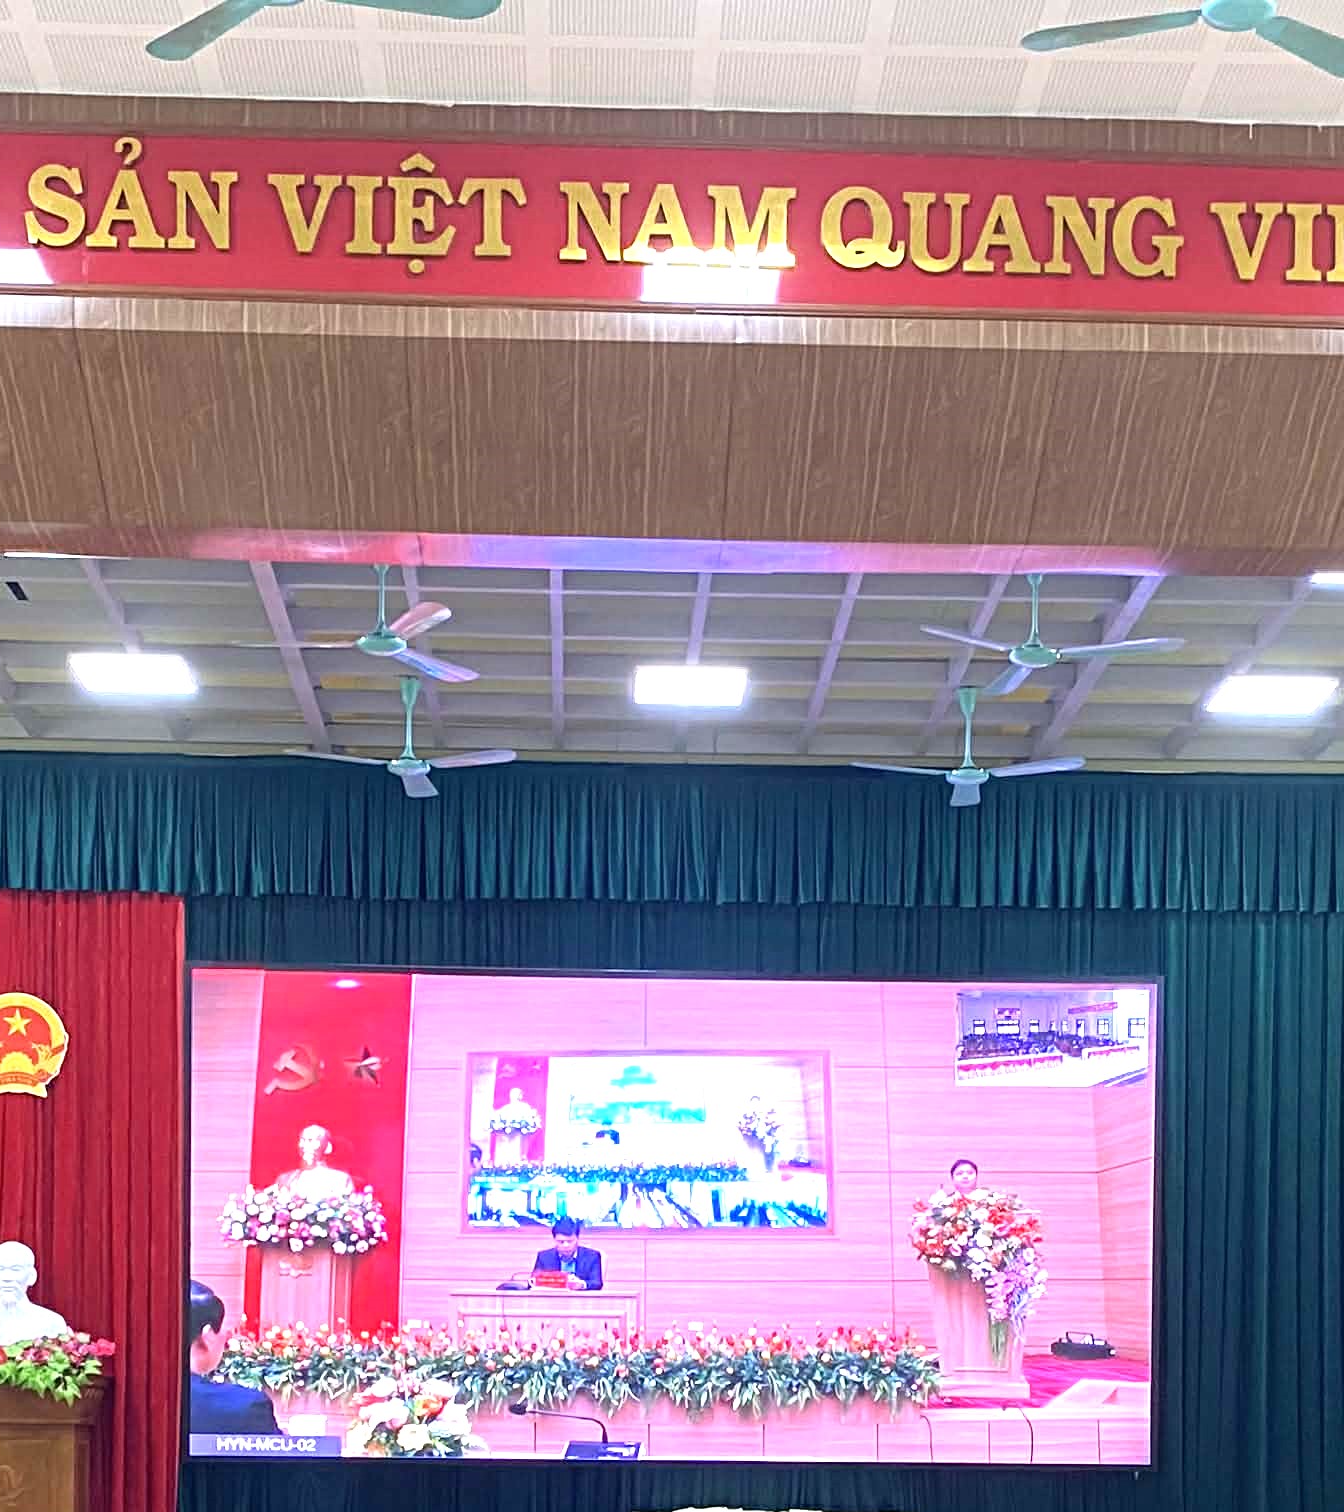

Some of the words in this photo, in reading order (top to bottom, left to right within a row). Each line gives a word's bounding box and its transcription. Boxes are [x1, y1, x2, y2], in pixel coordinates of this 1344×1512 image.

[26, 138, 238, 251] SẢN
[269, 152, 526, 274] VIỆT
[558, 181, 797, 270] NAM
[822, 187, 1184, 279] QUANG
[216, 1437, 316, 1452] HYN-MCU-02
